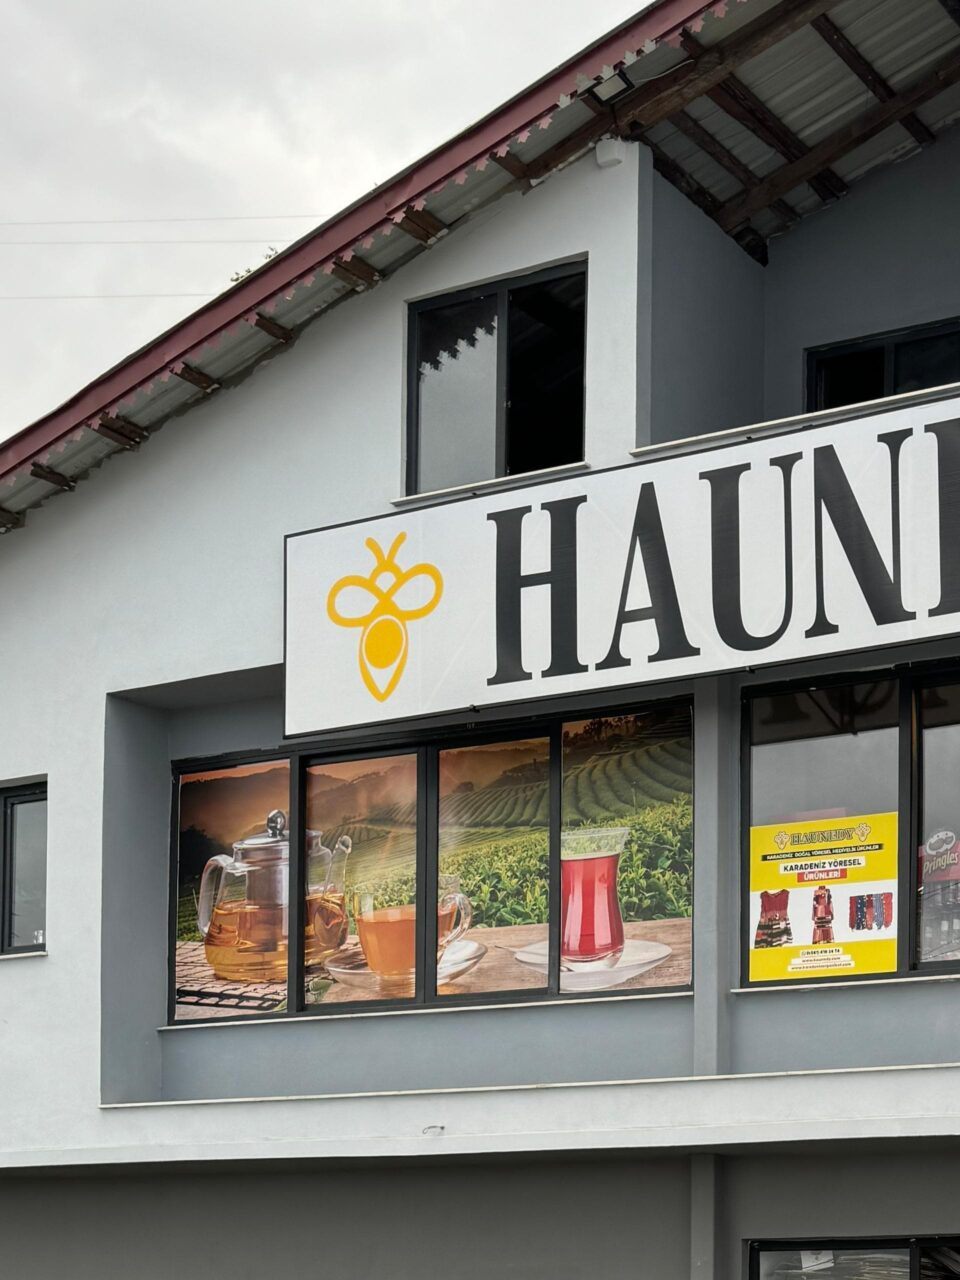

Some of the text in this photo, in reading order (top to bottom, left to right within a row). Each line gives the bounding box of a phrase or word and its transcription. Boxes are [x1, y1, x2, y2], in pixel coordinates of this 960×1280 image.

[790, 828, 856, 845] HAUNEDY
[783, 858, 861, 872] KARADENİZ YÖRESEL
[923, 851, 959, 880] Pringles
